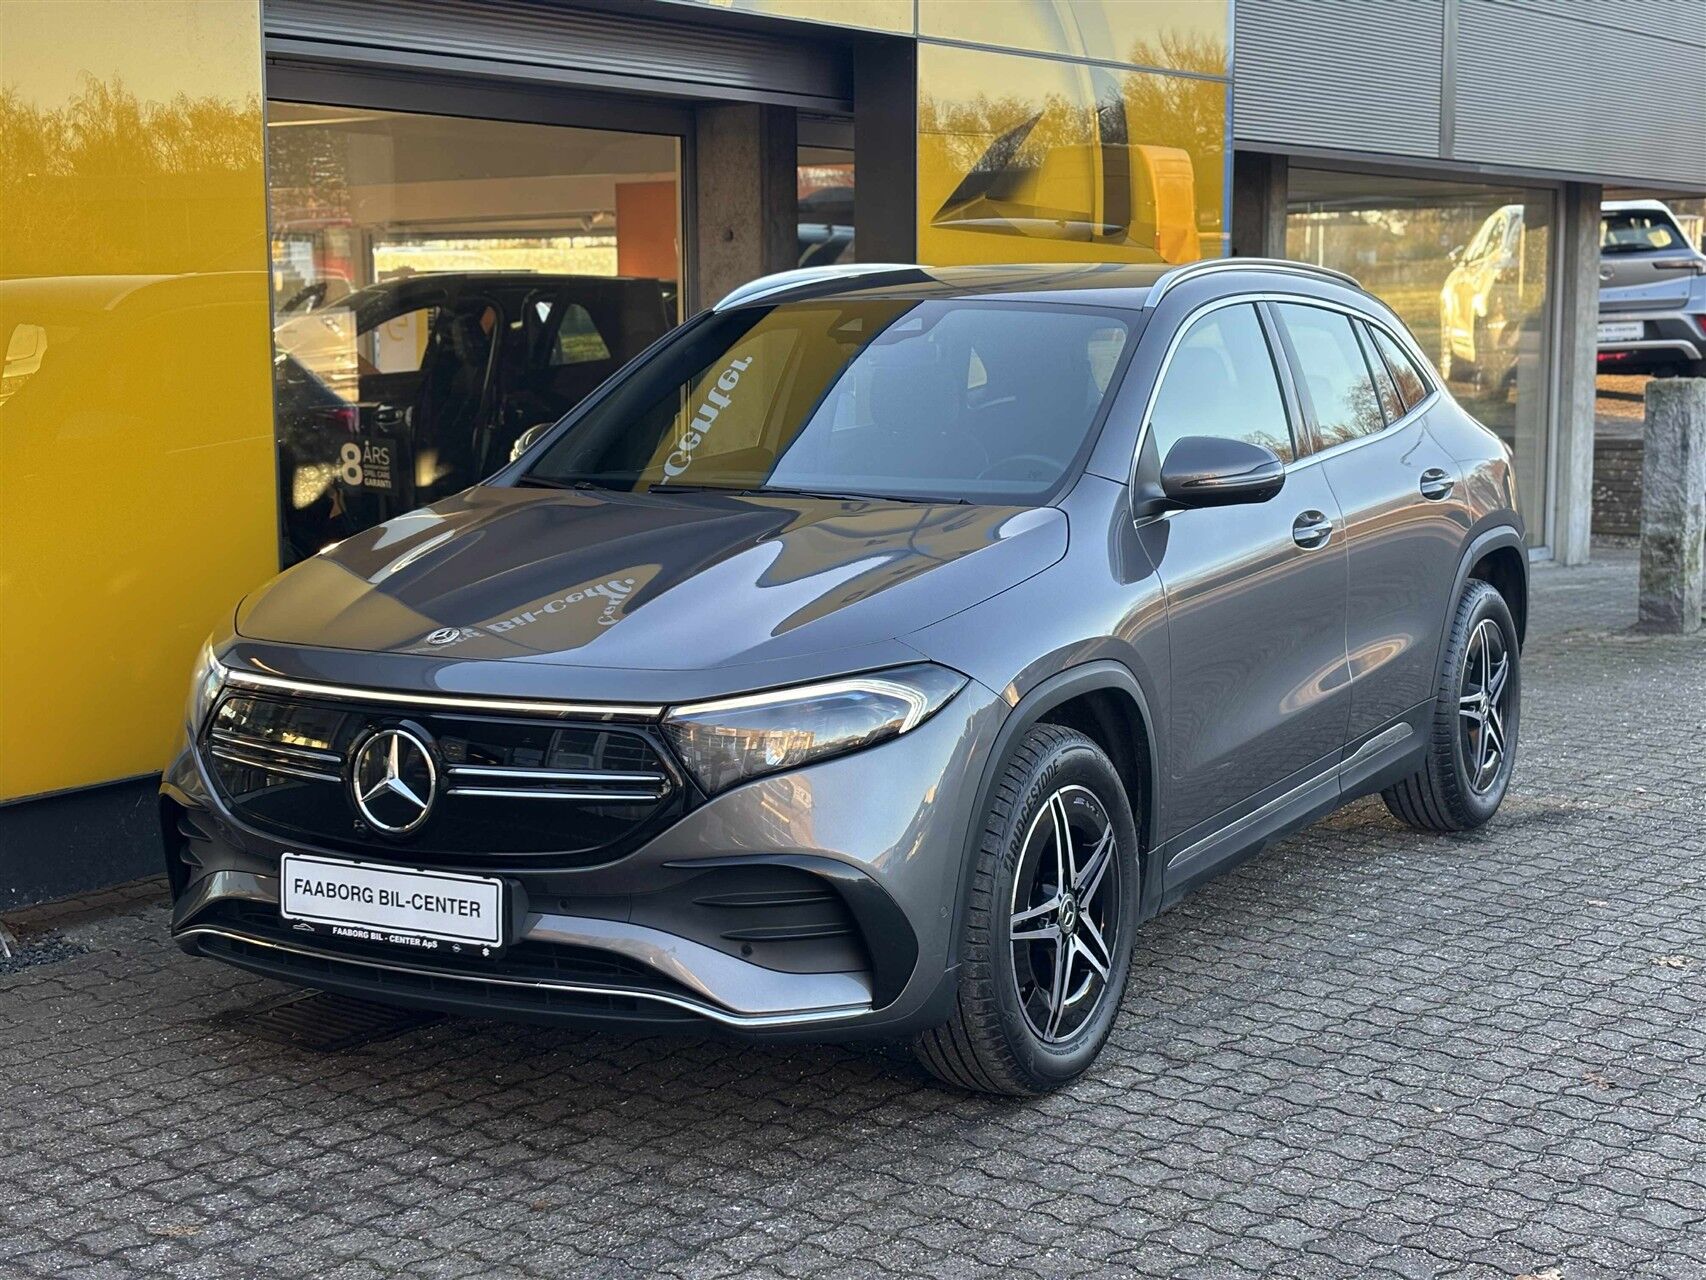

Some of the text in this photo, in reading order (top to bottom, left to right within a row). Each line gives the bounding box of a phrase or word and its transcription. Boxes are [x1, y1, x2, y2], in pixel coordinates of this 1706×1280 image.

[341, 440, 389, 486] 8 ÅRS
[364, 478, 392, 489] GARANTI
[1003, 758, 1061, 874] BRIDGESTONE
[294, 878, 481, 918] FAABORG BIL-CENTER
[332, 927, 369, 939] FAABORG
[370, 931, 384, 942] BIL
[389, 934, 421, 946] CENTER
[421, 939, 438, 949] ApS
